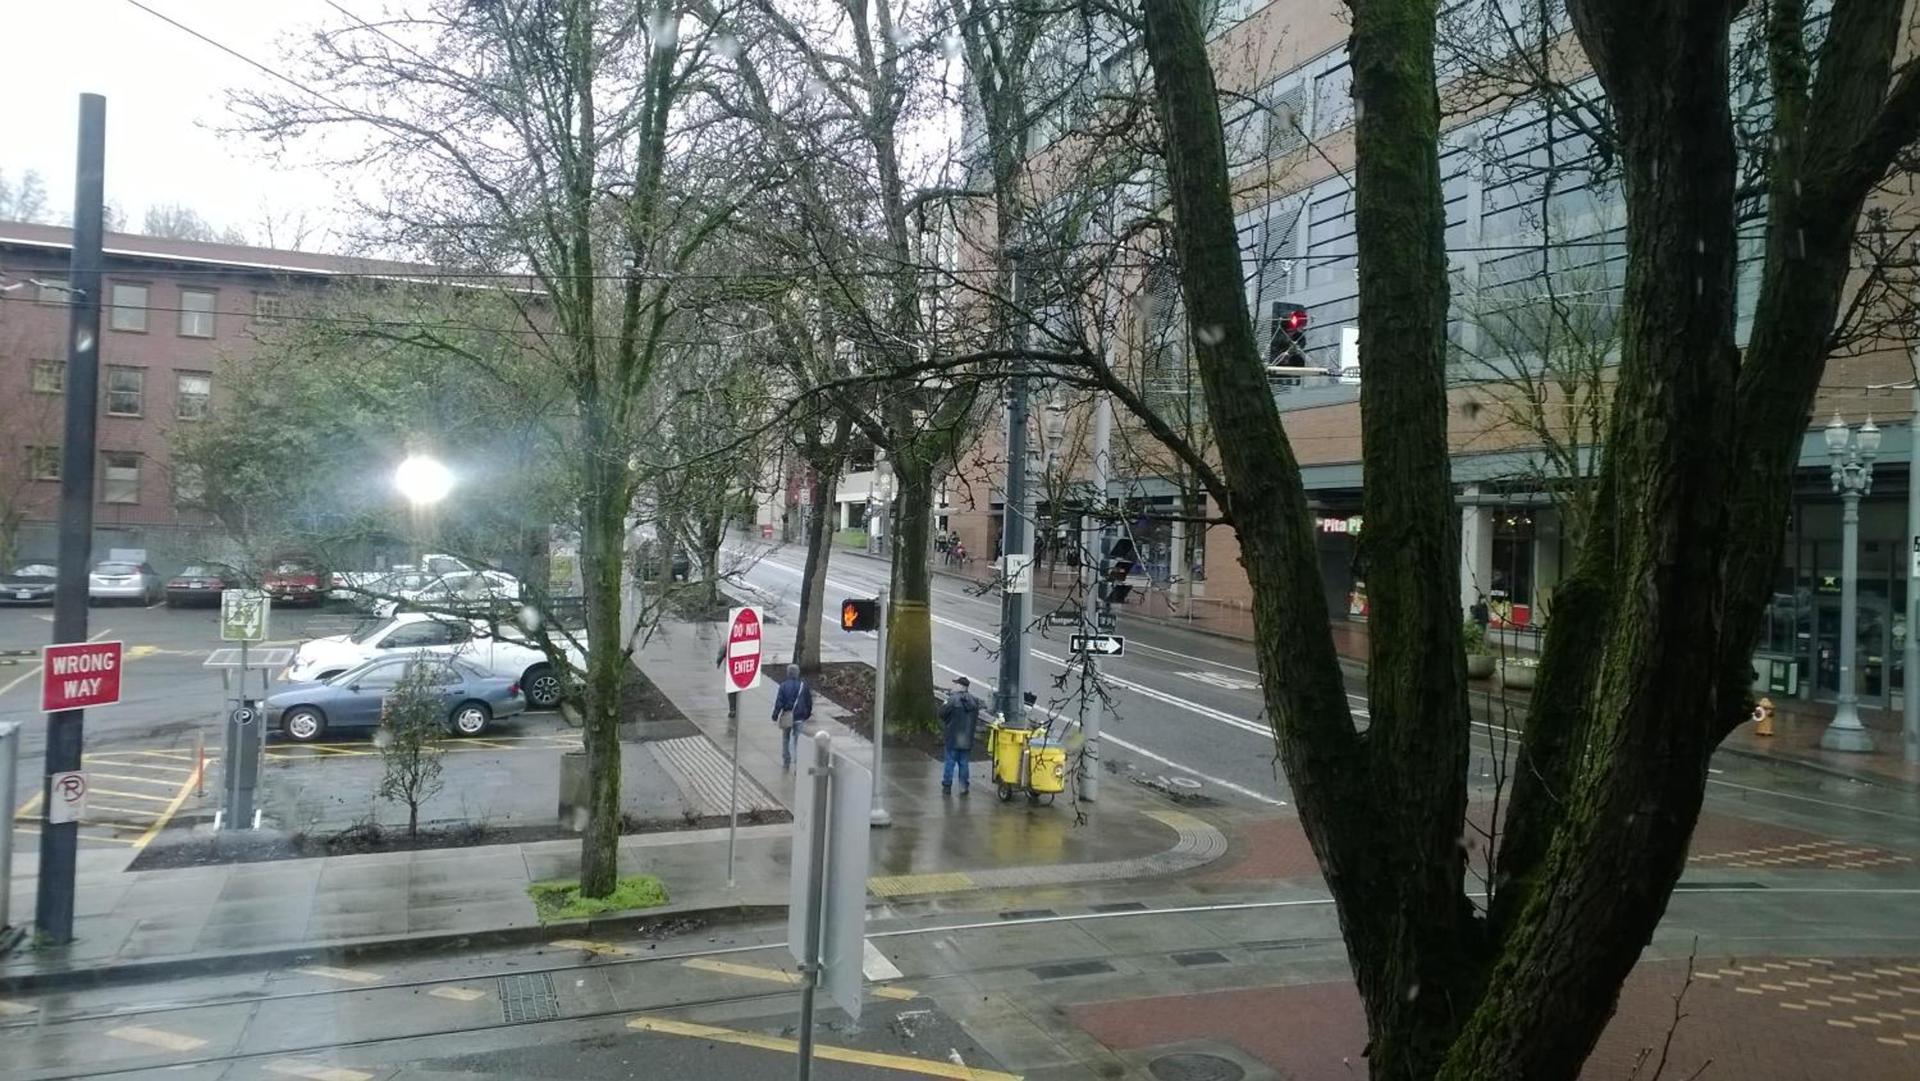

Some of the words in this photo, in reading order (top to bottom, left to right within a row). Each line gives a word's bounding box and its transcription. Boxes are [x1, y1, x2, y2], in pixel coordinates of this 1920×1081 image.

[1323, 518, 1347, 532] Pita
[1348, 518, 1364, 532] Pi
[733, 624, 743, 638] DO
[745, 622, 759, 636] NOT
[52, 652, 115, 676] WRONG
[734, 660, 755, 675] ENTER
[63, 677, 102, 699] WAY
